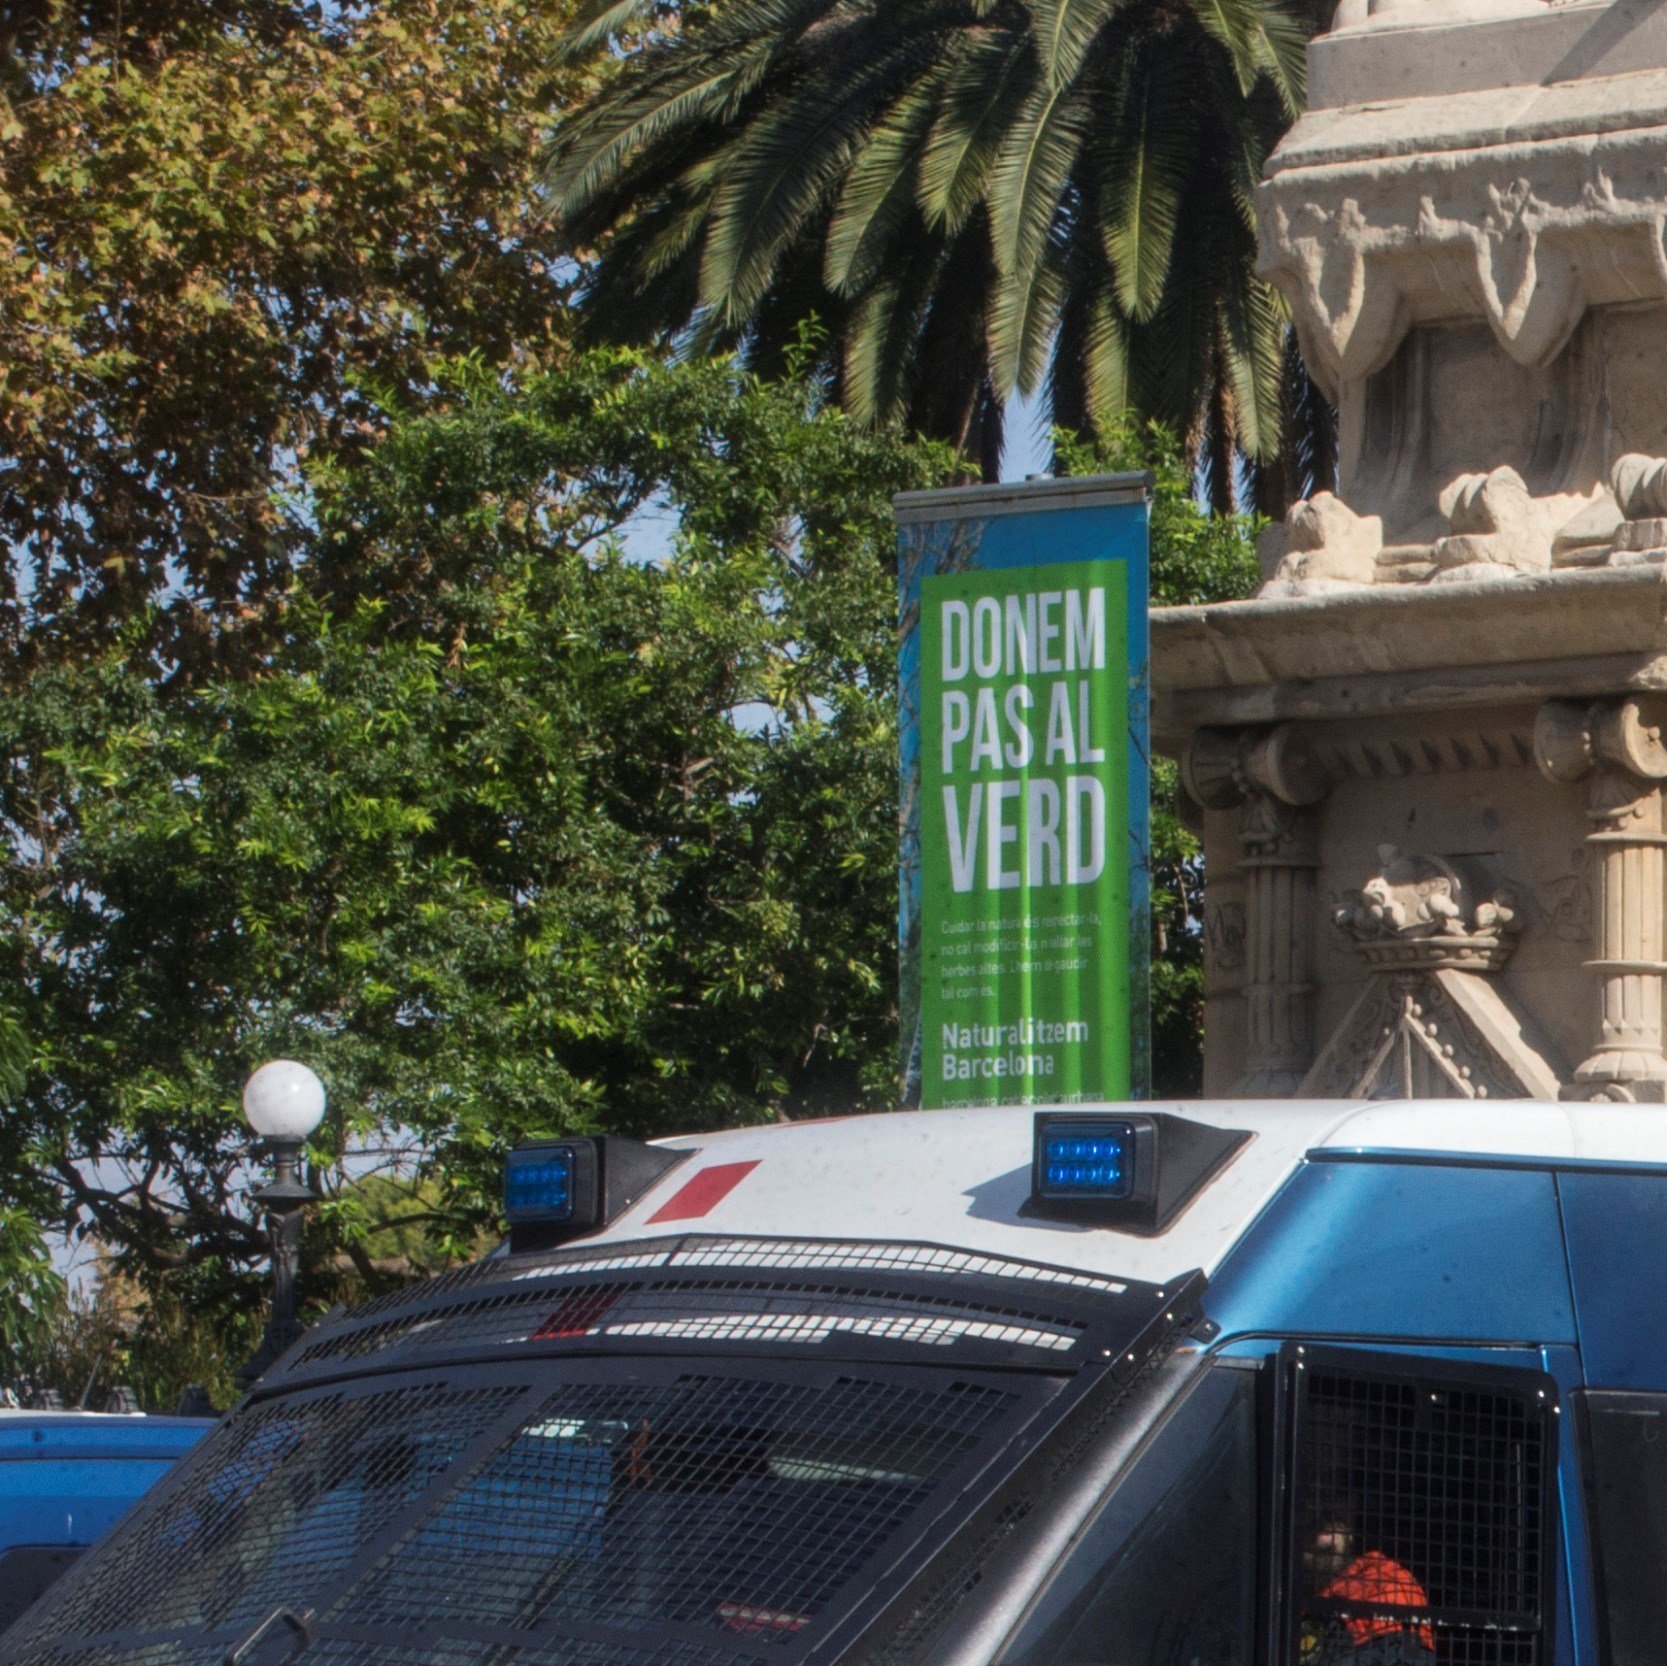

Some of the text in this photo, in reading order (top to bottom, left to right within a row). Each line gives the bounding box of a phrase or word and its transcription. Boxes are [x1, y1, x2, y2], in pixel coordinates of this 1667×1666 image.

[942, 587, 1105, 682] DONEM
[942, 680, 1105, 775] PAS AL
[942, 775, 1105, 893] VERD
[942, 1016, 1089, 1050] Naturalitzem
[942, 1049, 1054, 1081] Barcelona
